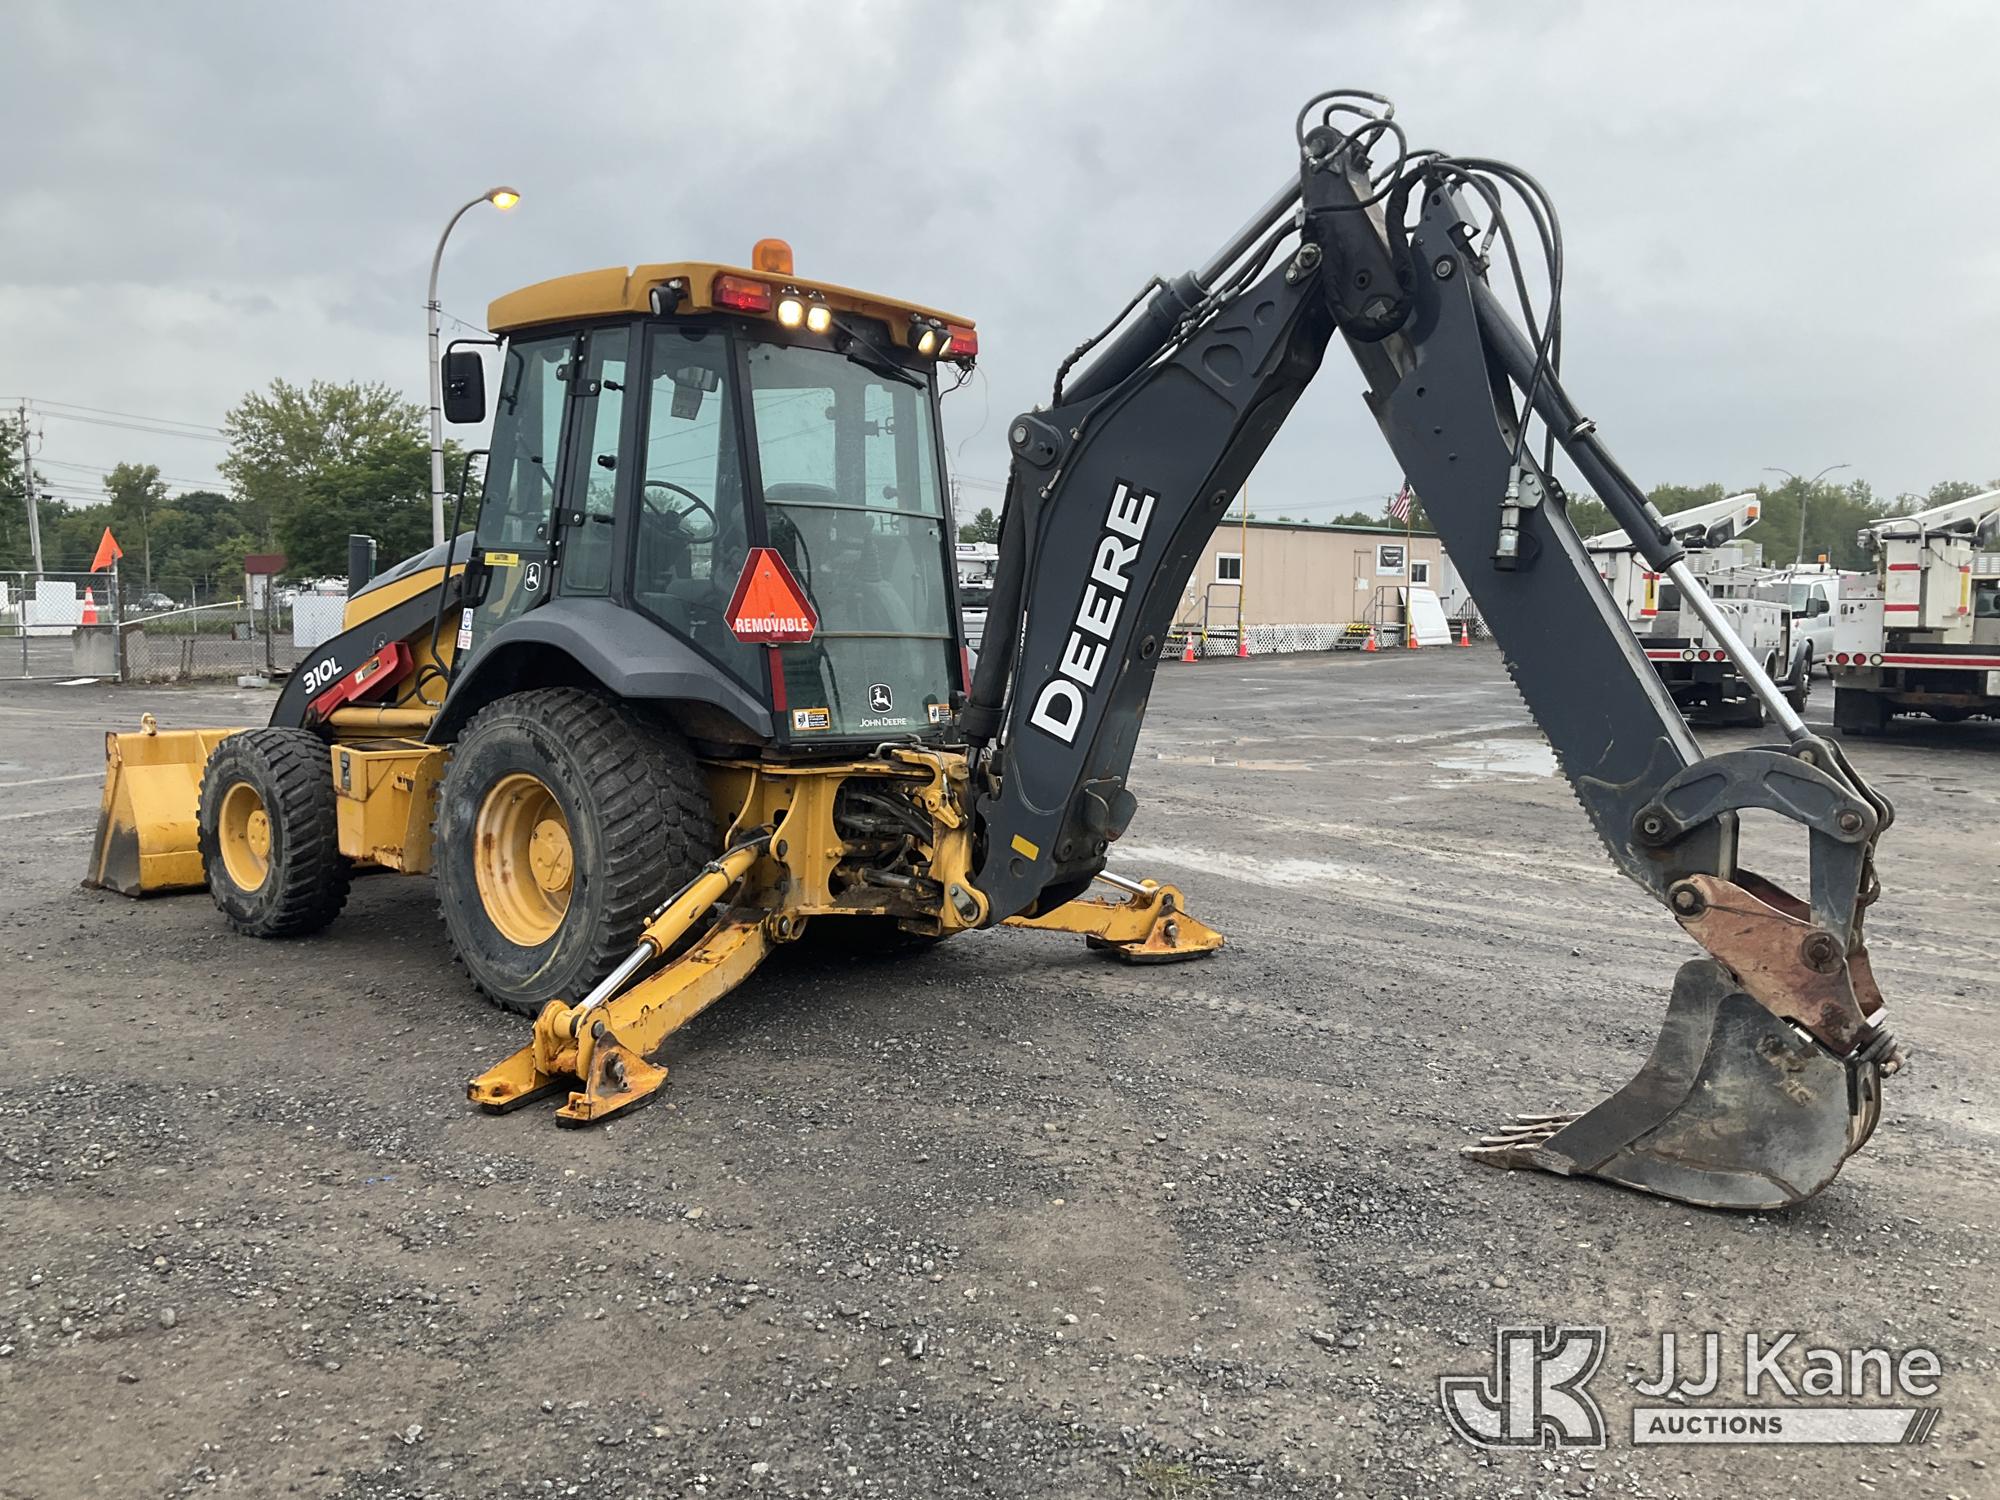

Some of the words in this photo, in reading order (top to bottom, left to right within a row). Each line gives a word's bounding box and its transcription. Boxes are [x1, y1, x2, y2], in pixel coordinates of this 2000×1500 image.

[735, 617, 809, 633] REMOVABLE
[1030, 483, 1156, 743] DEERE
[302, 656, 343, 695] 310L
[859, 717, 882, 728] JOHN
[883, 717, 907, 727] DEERE
